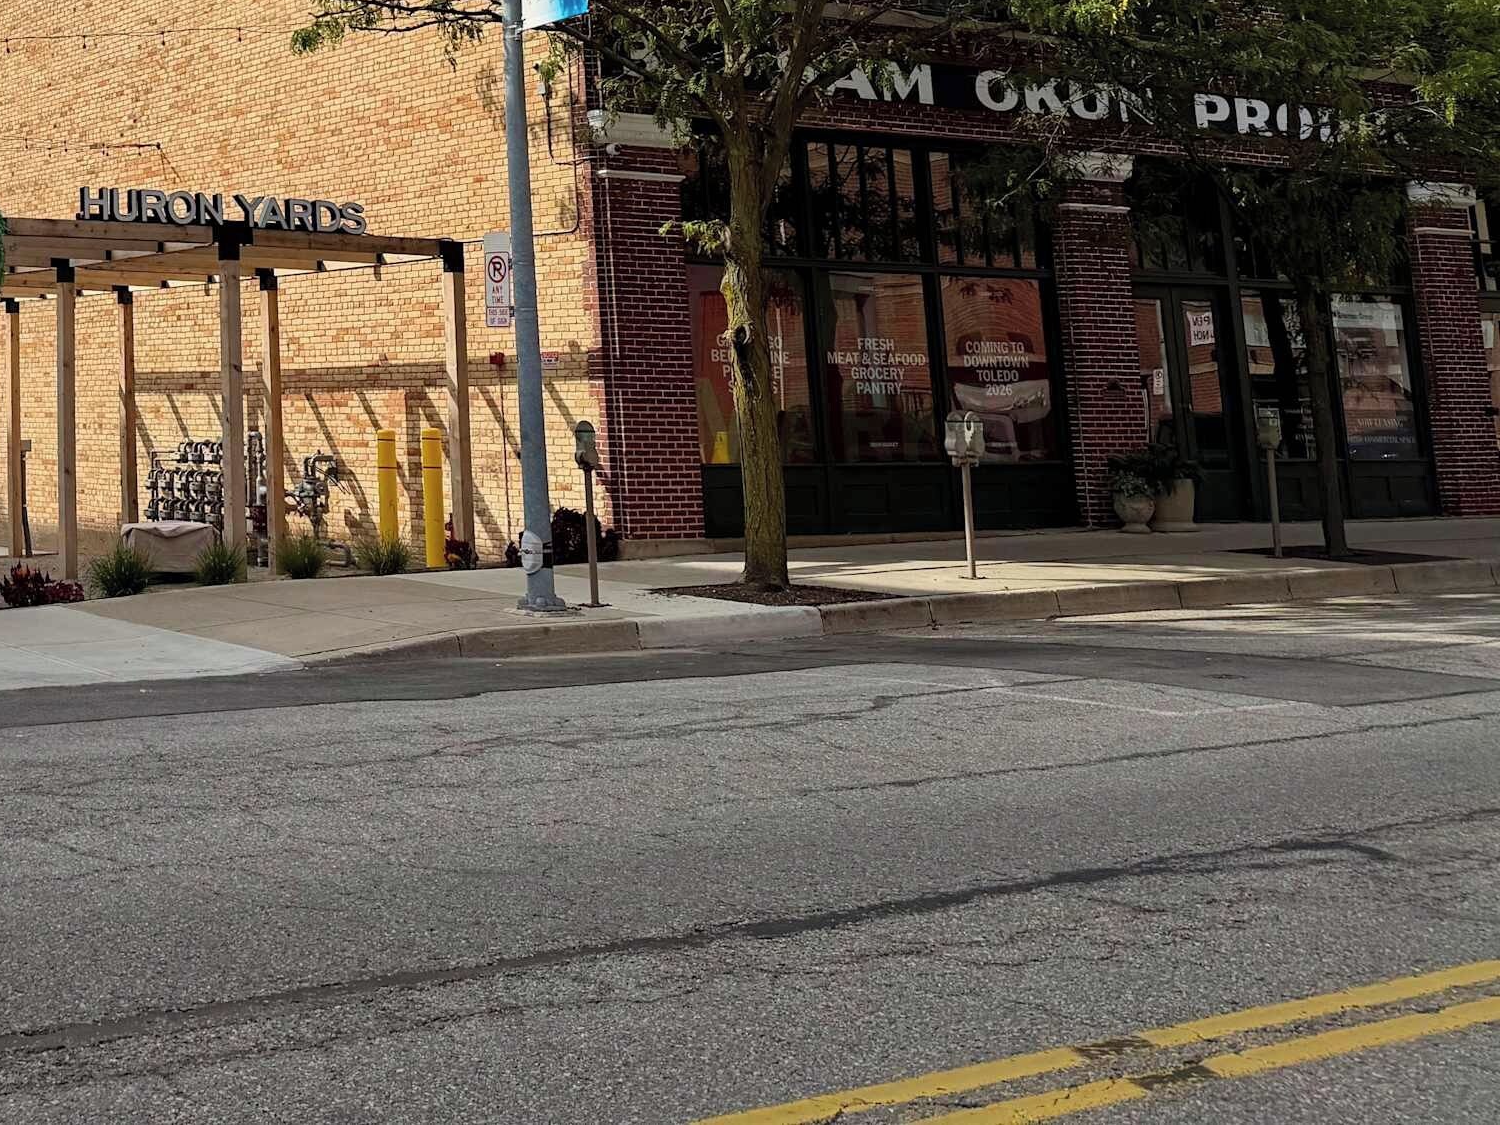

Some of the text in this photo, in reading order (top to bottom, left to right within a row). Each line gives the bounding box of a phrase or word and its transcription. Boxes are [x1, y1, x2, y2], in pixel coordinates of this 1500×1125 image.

[975, 71, 1154, 126] OKUN
[80, 186, 367, 235] HURON YARDS
[857, 338, 895, 351] FRESH
[965, 341, 1025, 354] COMING TO
[827, 351, 926, 366] MEAT & SEAFOOD
[963, 354, 1030, 368] DOWNTOWN
[851, 366, 905, 380] GROCERY
[976, 370, 1020, 383] TOLEDO
[856, 382, 902, 396] PANTRY
[986, 384, 1013, 396] 2026
